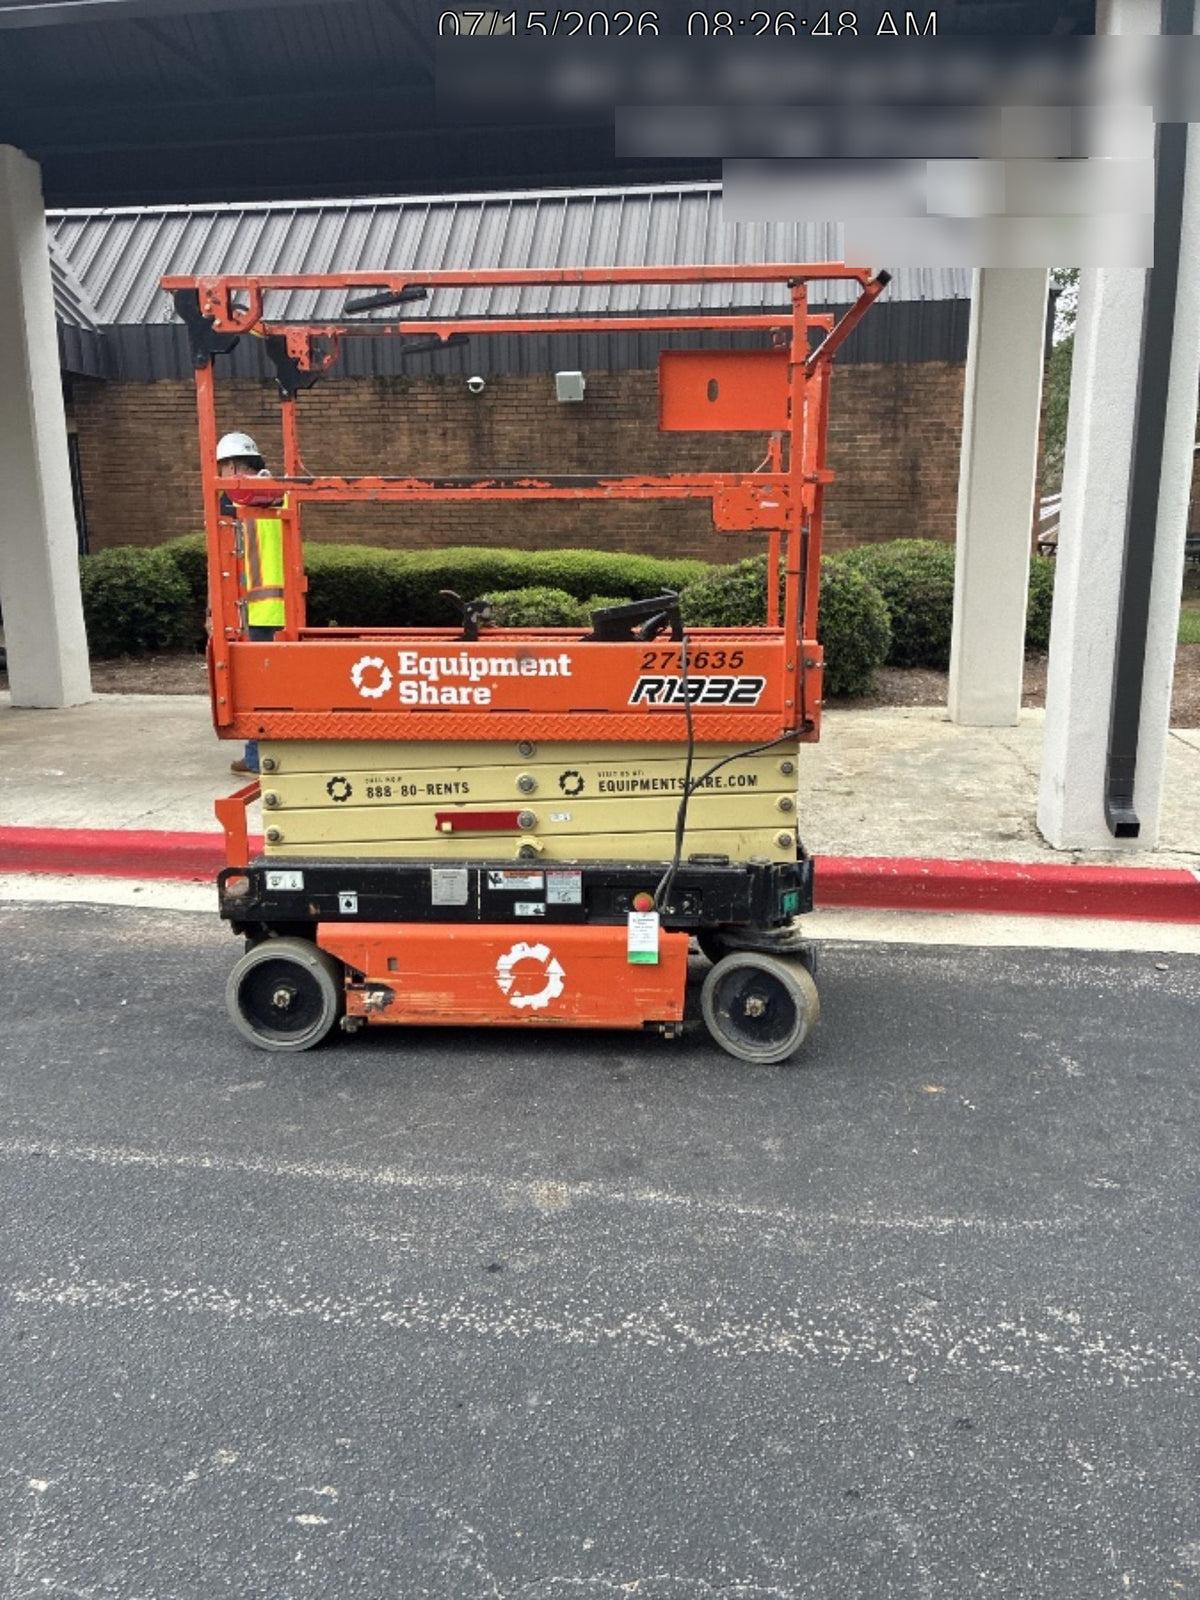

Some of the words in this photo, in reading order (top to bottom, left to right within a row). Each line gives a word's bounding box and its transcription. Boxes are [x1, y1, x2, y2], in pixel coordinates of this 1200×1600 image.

[398, 651, 573, 682] Equipment
[640, 650, 745, 670] 275635
[399, 680, 492, 705] Share
[627, 675, 767, 707] R1932
